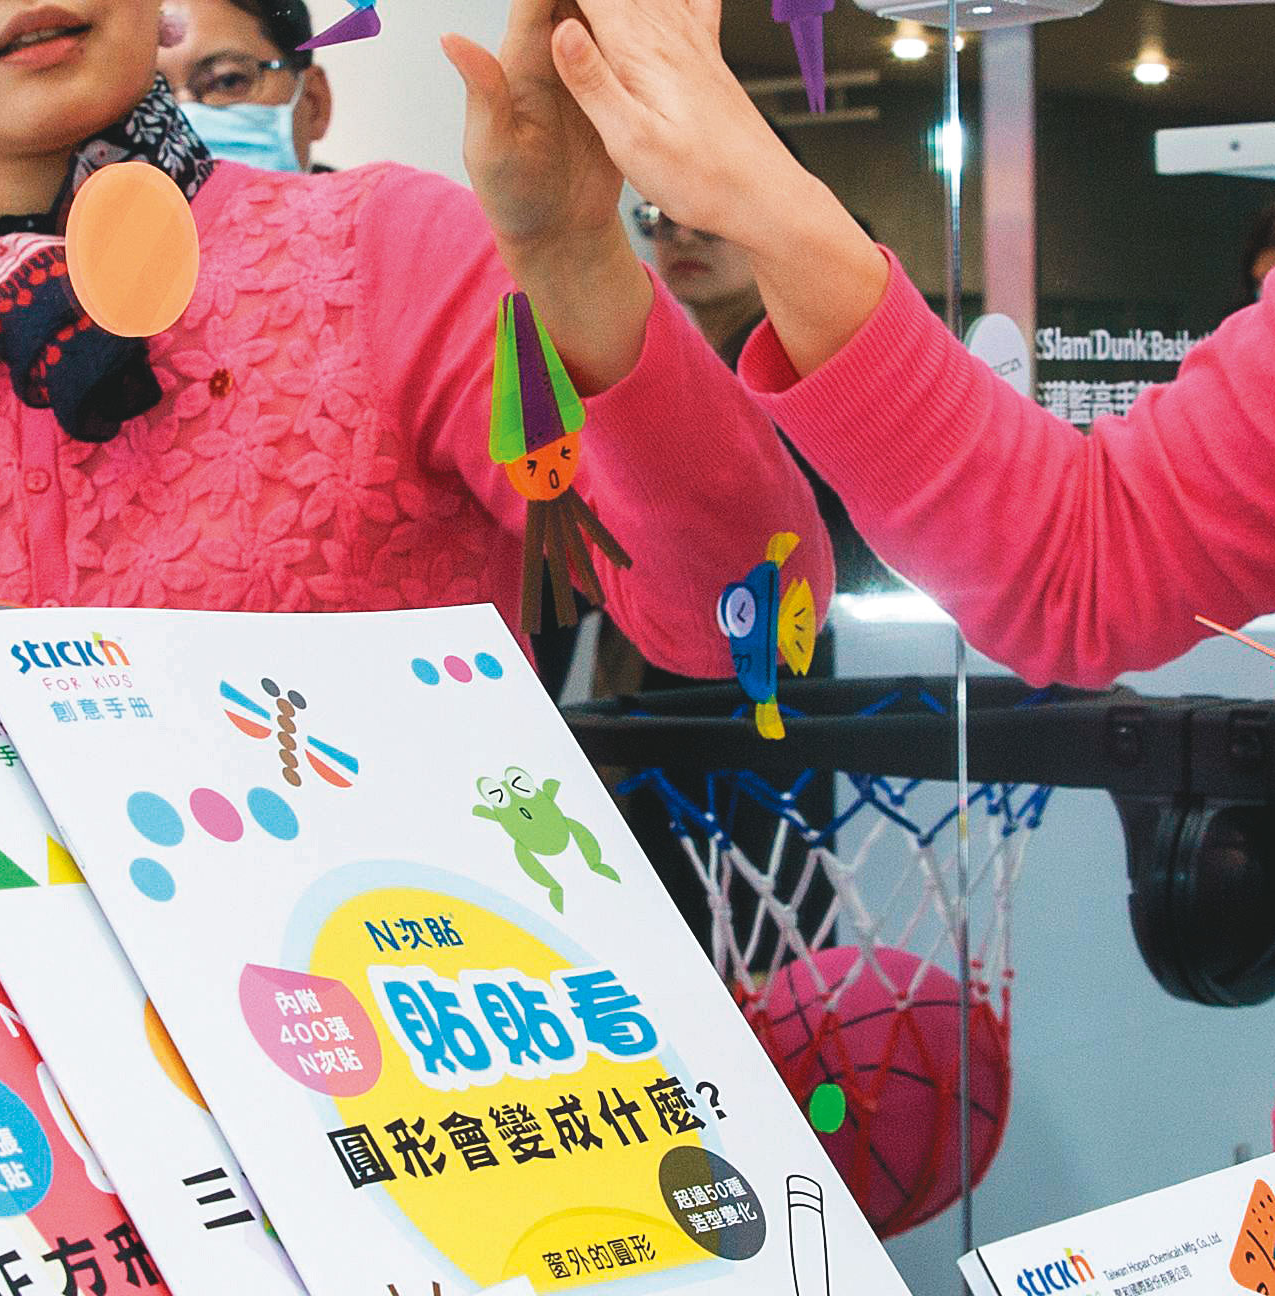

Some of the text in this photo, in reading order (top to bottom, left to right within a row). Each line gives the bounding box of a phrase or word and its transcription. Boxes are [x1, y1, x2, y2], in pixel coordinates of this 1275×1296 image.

[1041, 326, 1212, 362] Slam Dunk Bask
[42, 674, 134, 692] FOR KIDS
[364, 915, 464, 952] N次貼
[279, 1016, 355, 1046] 400張
[382, 969, 658, 1074] 貼貼看
[296, 1046, 364, 1076] N次貼
[181, 1166, 256, 1230] 三
[672, 1176, 748, 1211] 超過50種
[687, 1201, 758, 1234] 造型變化
[1102, 1266, 1129, 1281] Taiwan
[1126, 1257, 1151, 1274] Hopax
[1148, 1245, 1184, 1266] Chemicals
